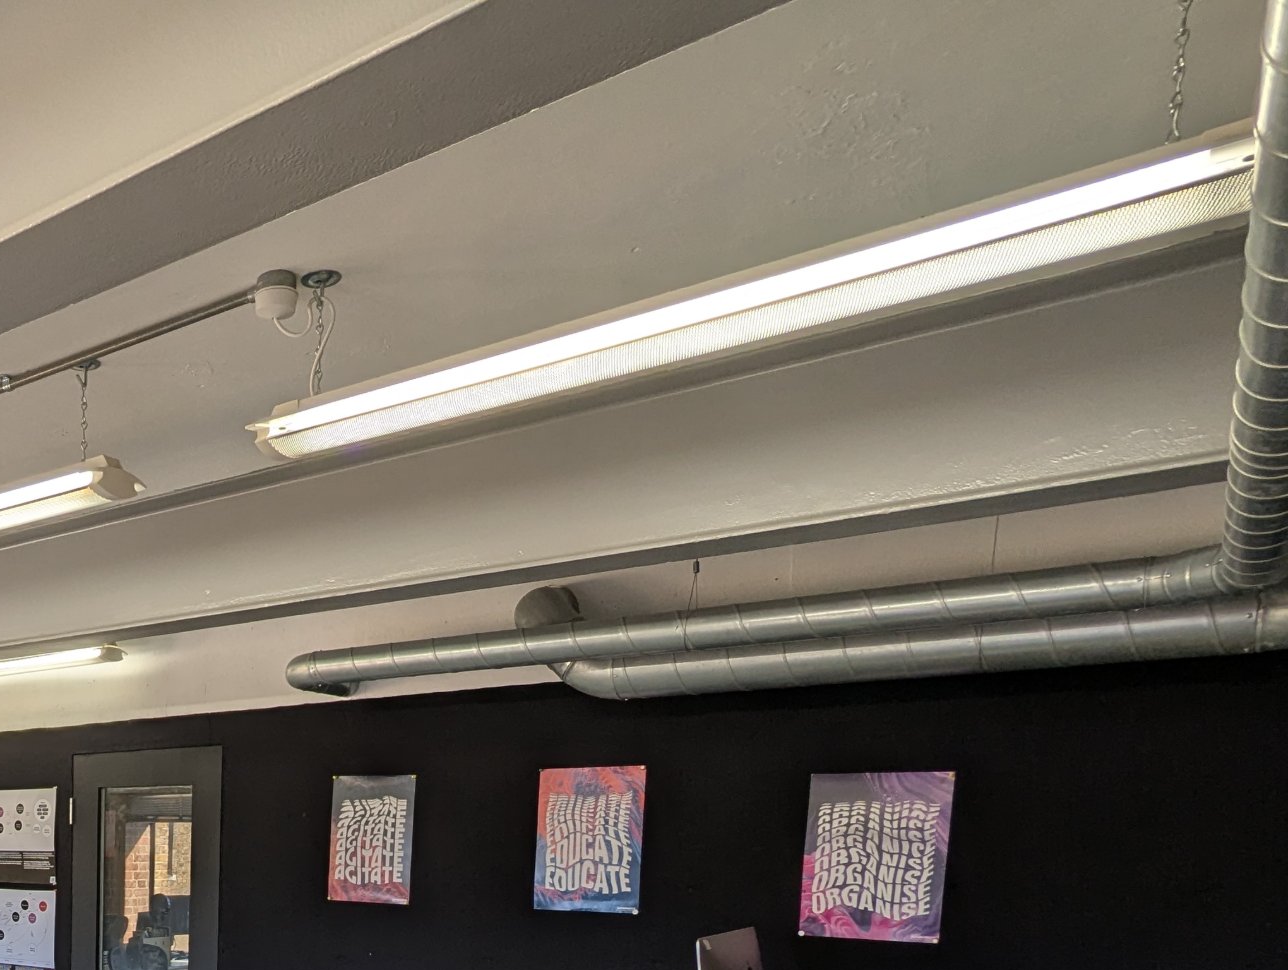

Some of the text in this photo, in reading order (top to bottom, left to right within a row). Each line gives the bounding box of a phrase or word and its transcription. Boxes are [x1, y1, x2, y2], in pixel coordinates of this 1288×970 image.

[335, 846, 404, 868] AGITATE
[336, 835, 405, 853] AGITATE
[545, 832, 632, 869] EDUCATE
[334, 864, 403, 885] AGITATE
[544, 859, 632, 894] EDUCATE
[813, 863, 931, 903] ORGANISE
[815, 847, 933, 885] ORGANISE
[812, 885, 930, 920] ORGANISE
